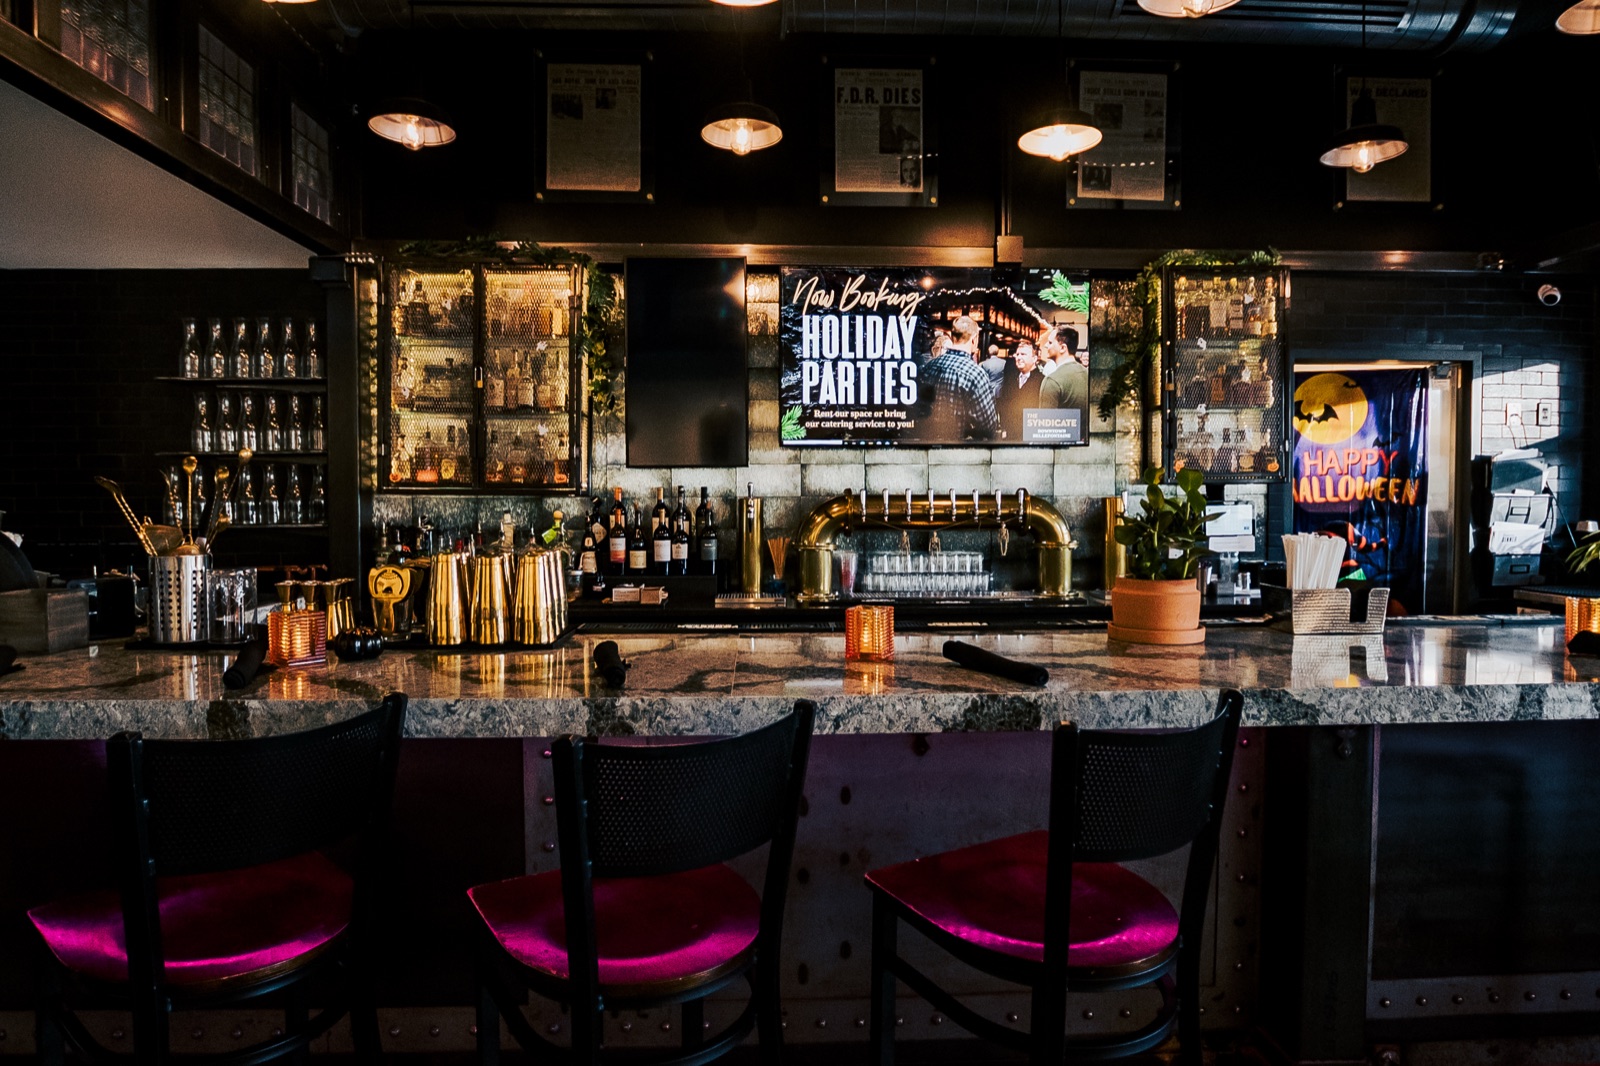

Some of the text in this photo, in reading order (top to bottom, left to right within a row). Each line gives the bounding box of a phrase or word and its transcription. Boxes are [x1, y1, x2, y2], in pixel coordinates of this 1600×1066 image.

[837, 86, 921, 104] F.D.R. DIES
[1376, 88, 1428, 98] DECLARED
[792, 274, 926, 323] Now Booking
[802, 314, 918, 359] HOLIDAY
[802, 361, 918, 405] PARTIES
[814, 409, 833, 418] Rent
[850, 410, 872, 419] space
[884, 409, 906, 419] bring
[1027, 419, 1077, 427] SYNDICATE
[821, 420, 853, 429] catering
[855, 420, 885, 428] services
[887, 420, 896, 428] to
[897, 420, 915, 429] you!
[1303, 448, 1398, 476] HAPPY
